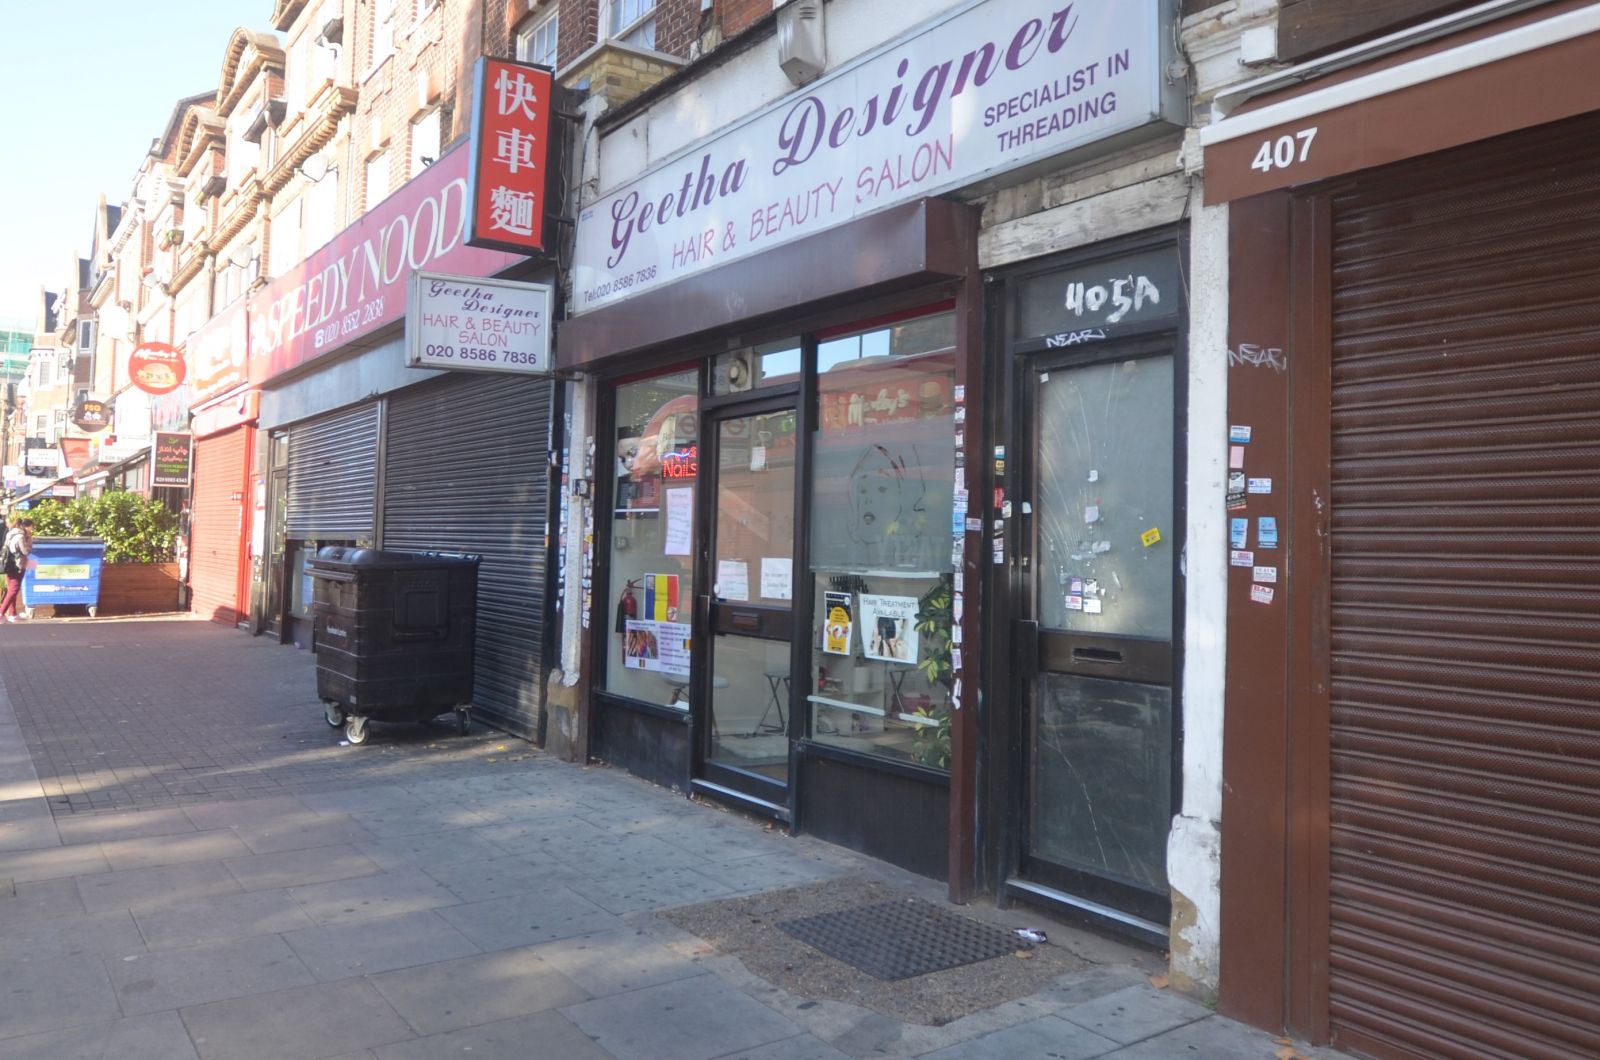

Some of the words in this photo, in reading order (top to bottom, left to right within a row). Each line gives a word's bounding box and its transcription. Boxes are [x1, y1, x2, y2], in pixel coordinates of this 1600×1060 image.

[984, 62, 1099, 127] SPECIALIST
[1108, 49, 1130, 78] IN
[606, 154, 748, 269] Geetha
[773, 2, 1079, 176] Designer
[997, 91, 1117, 152] THREADING
[1251, 127, 1318, 172] 407
[672, 228, 715, 270] HAIR
[722, 221, 736, 252] &
[750, 176, 843, 242] BEAUTY
[856, 133, 954, 204] SALON
[268, 246, 360, 347] SPEEDY
[428, 280, 495, 301] Geetha
[613, 273, 634, 293] 8586
[635, 265, 657, 284] 7836
[1065, 274, 1160, 323] 405A
[423, 313, 459, 329] HAIR
[465, 316, 476, 330] &
[482, 318, 541, 336] BEAUTY
[461, 299, 540, 319] Designer
[426, 344, 454, 358] 020
[460, 347, 497, 361] 8586
[502, 350, 537, 365] 7836
[458, 330, 508, 347] SALON
